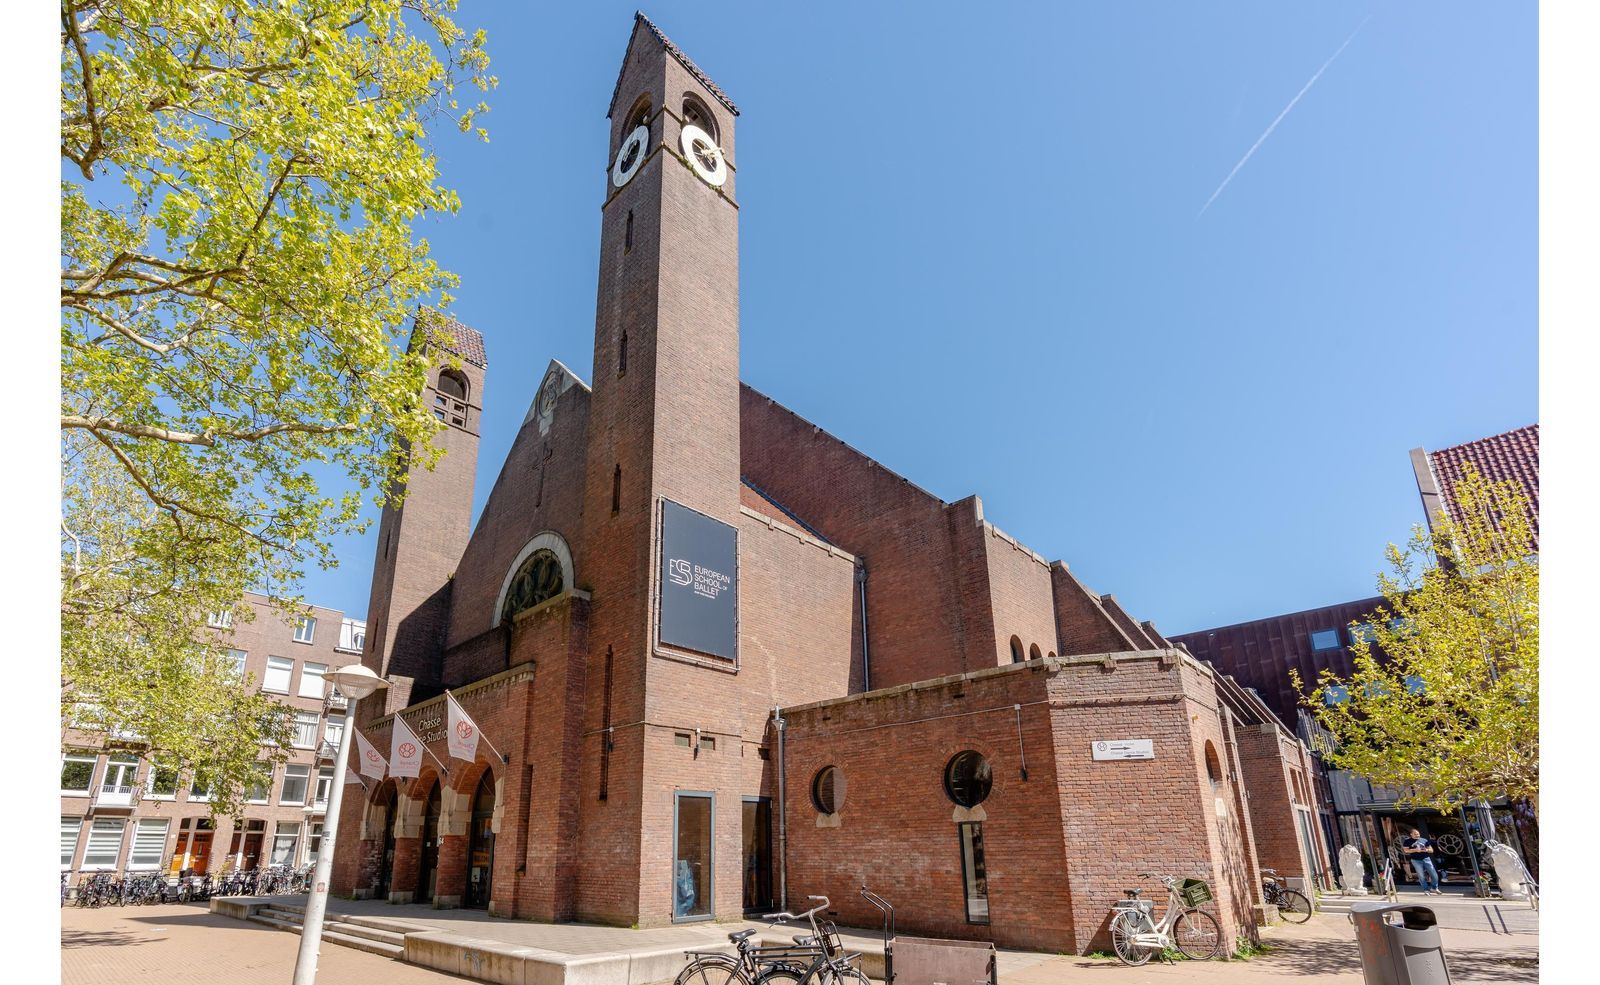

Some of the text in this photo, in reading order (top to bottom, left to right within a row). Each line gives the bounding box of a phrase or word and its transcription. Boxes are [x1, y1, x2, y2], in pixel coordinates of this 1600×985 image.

[694, 565, 730, 583] EUROPEAN
[694, 574, 721, 589] SCHOOL
[694, 581, 719, 596] BALLET
[427, 729, 448, 743] Studio
